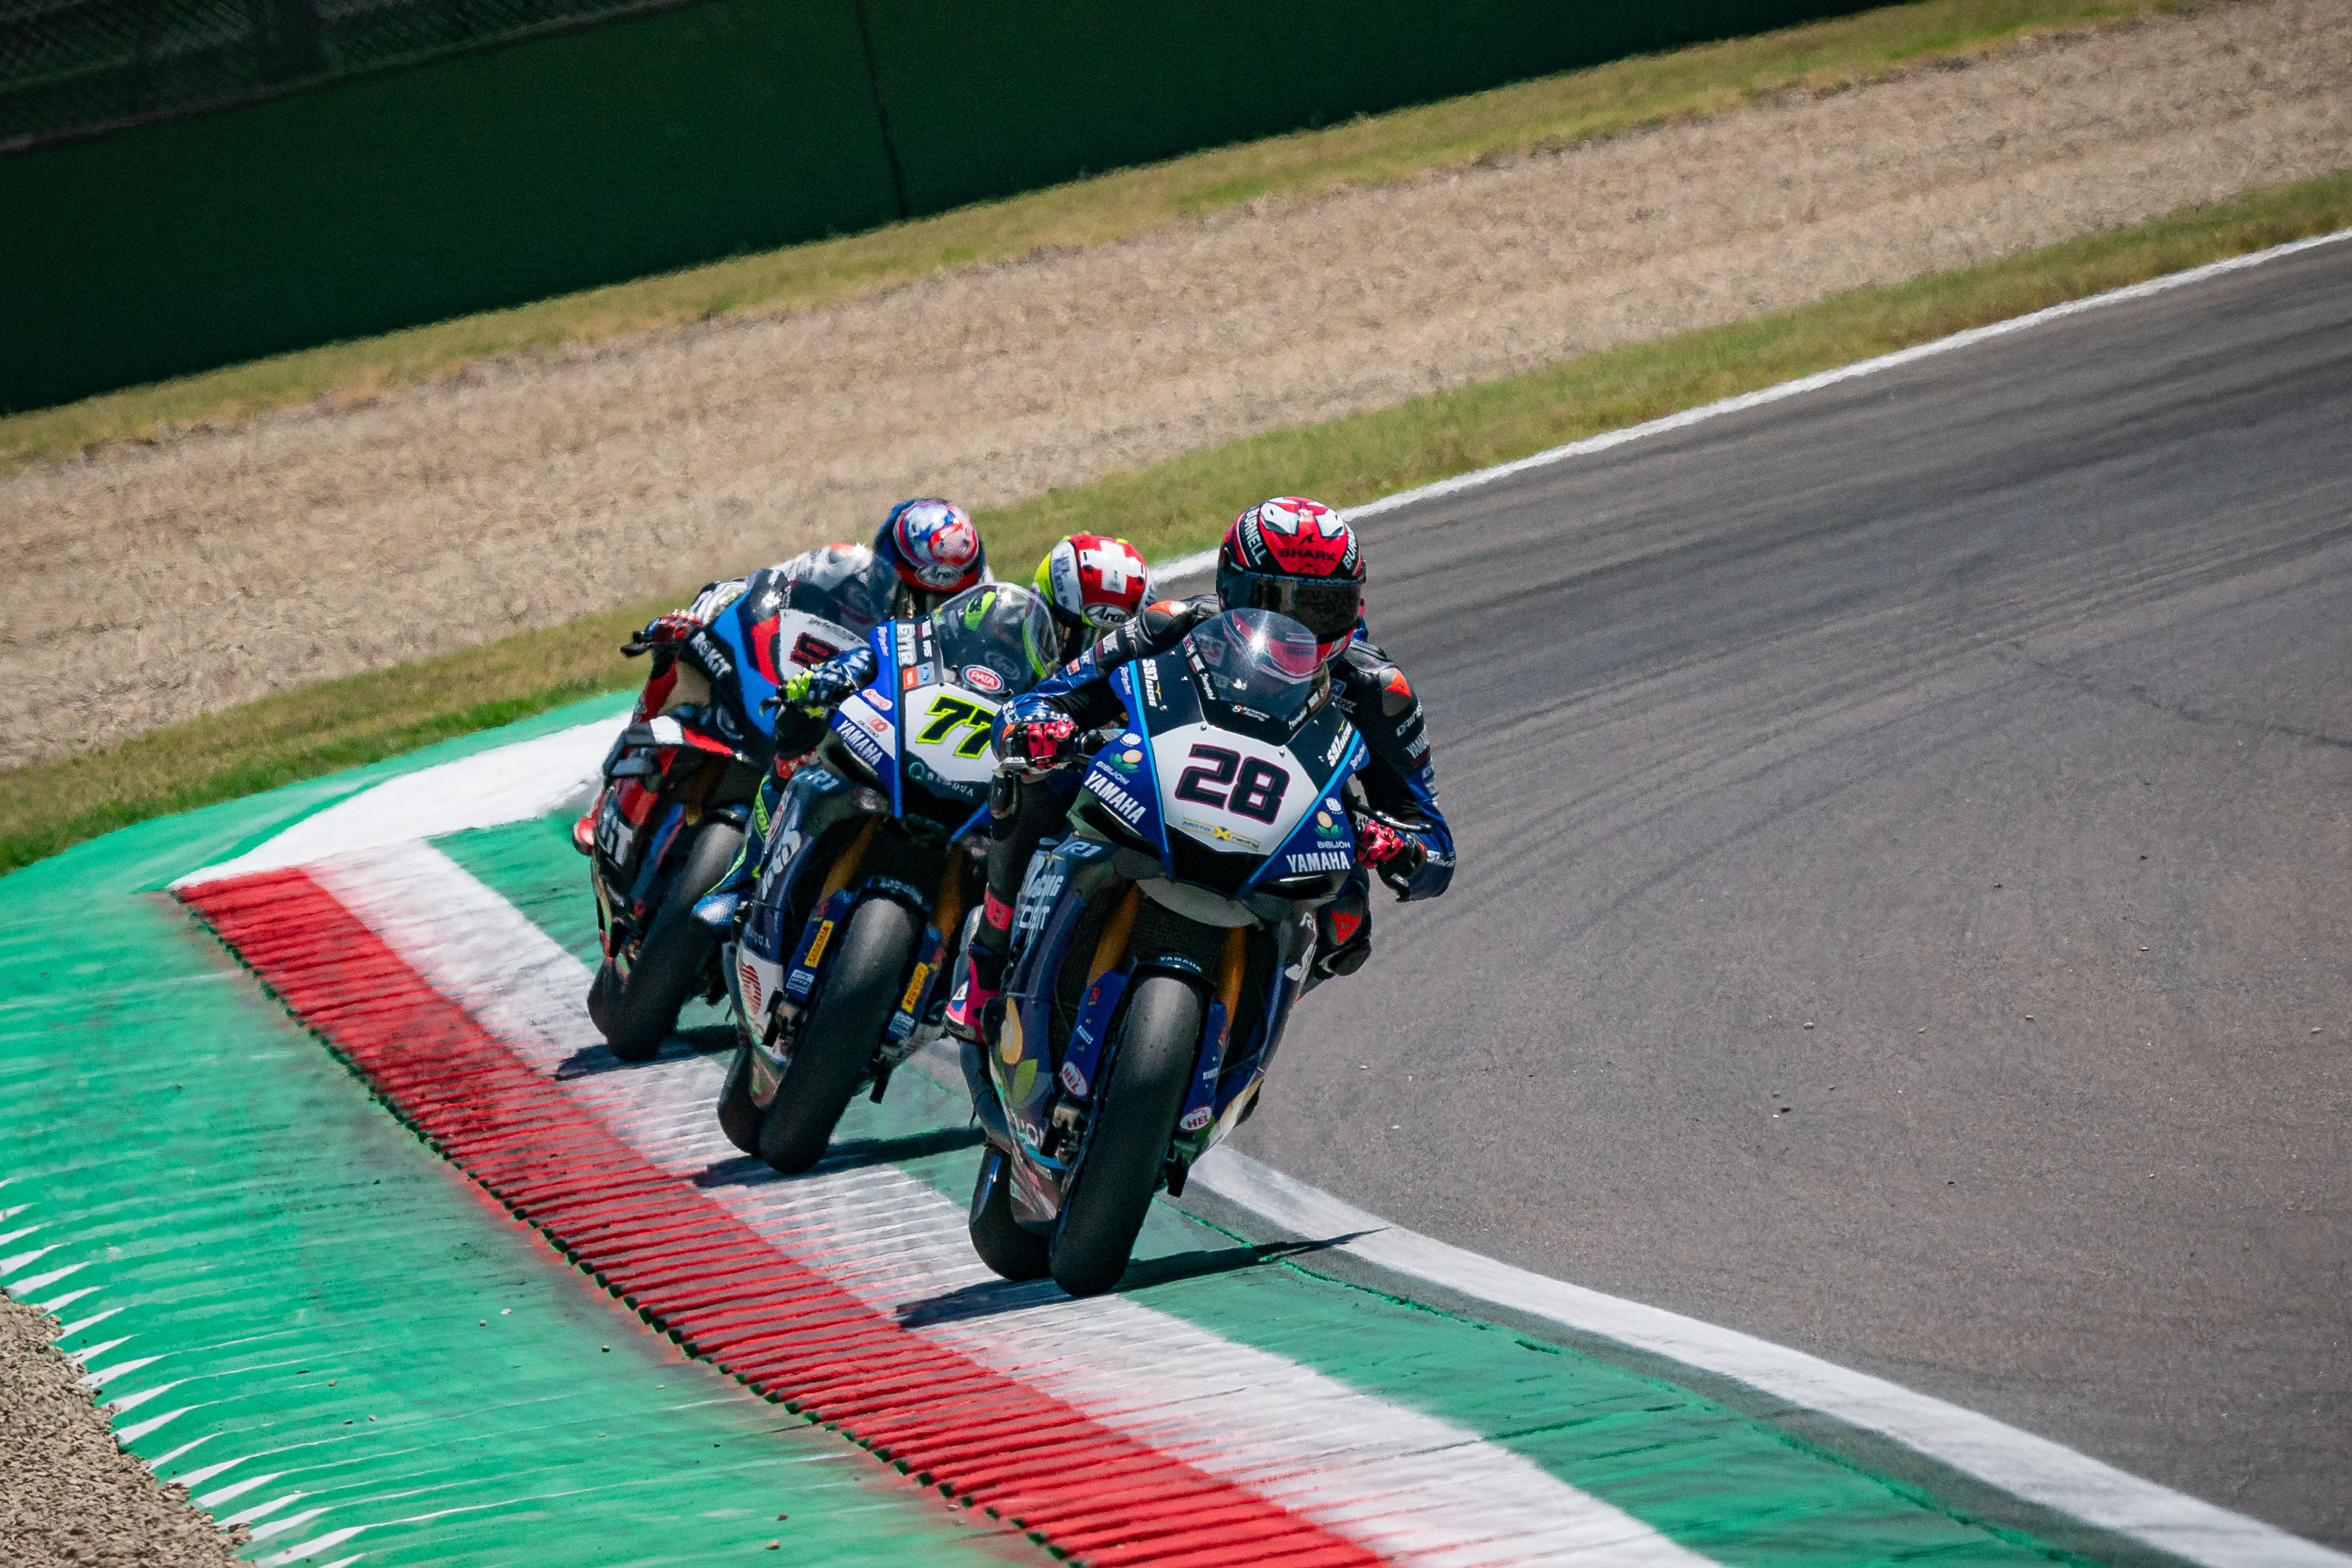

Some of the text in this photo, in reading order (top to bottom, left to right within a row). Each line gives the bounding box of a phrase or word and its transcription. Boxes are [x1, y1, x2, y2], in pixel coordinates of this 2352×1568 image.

[1245, 507, 1268, 566] BURNELL
[1278, 548, 1336, 562] SHARK
[897, 623, 917, 667] GYTR
[970, 670, 994, 687] PATA
[915, 693, 996, 759] 77
[837, 719, 883, 765] YAMAHA
[1174, 743, 1291, 826] 28
[1084, 770, 1147, 824] YAMAHA
[1182, 820, 1211, 833] MOTO
[1317, 840, 1351, 849] BIBLION
[1285, 851, 1351, 873] YAMAHA
[1159, 956, 1202, 972] YAMAHA
[1064, 1066, 1079, 1091] HEL
[1186, 1116, 1209, 1129] HEL
